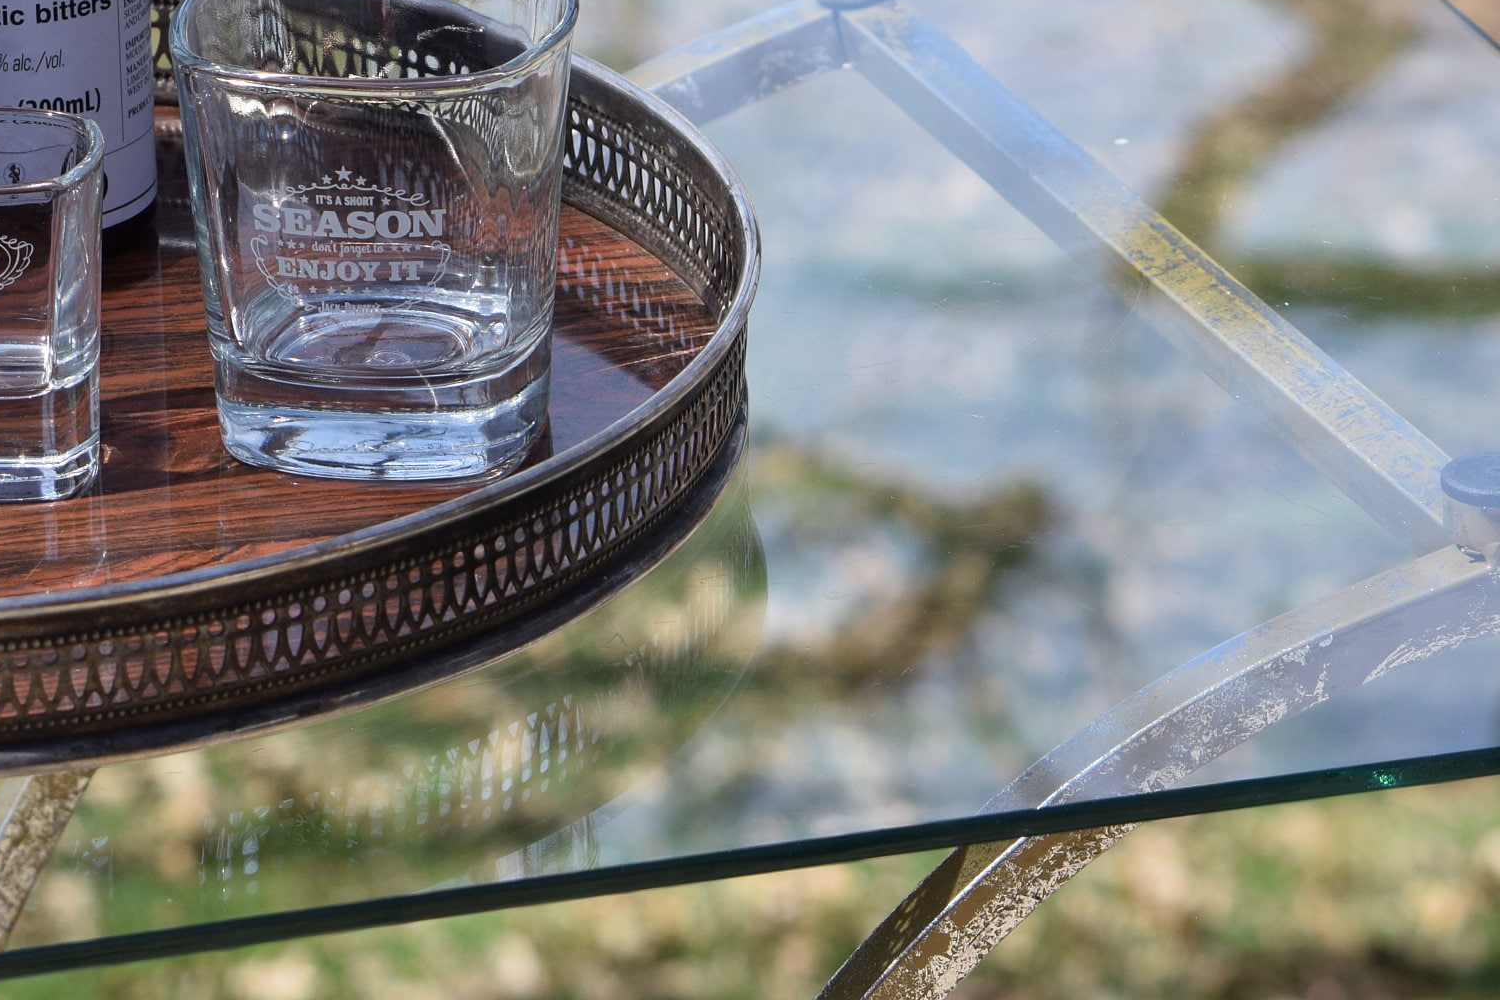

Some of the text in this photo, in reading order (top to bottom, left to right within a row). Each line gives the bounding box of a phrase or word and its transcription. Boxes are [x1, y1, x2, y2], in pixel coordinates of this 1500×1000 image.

[12, 49, 66, 74] alc./vol.
[315, 194, 375, 207] IT'S A SHORT
[252, 203, 447, 239] SEASON
[311, 240, 385, 258] don't forget to
[276, 255, 424, 282] ENJOY IT
